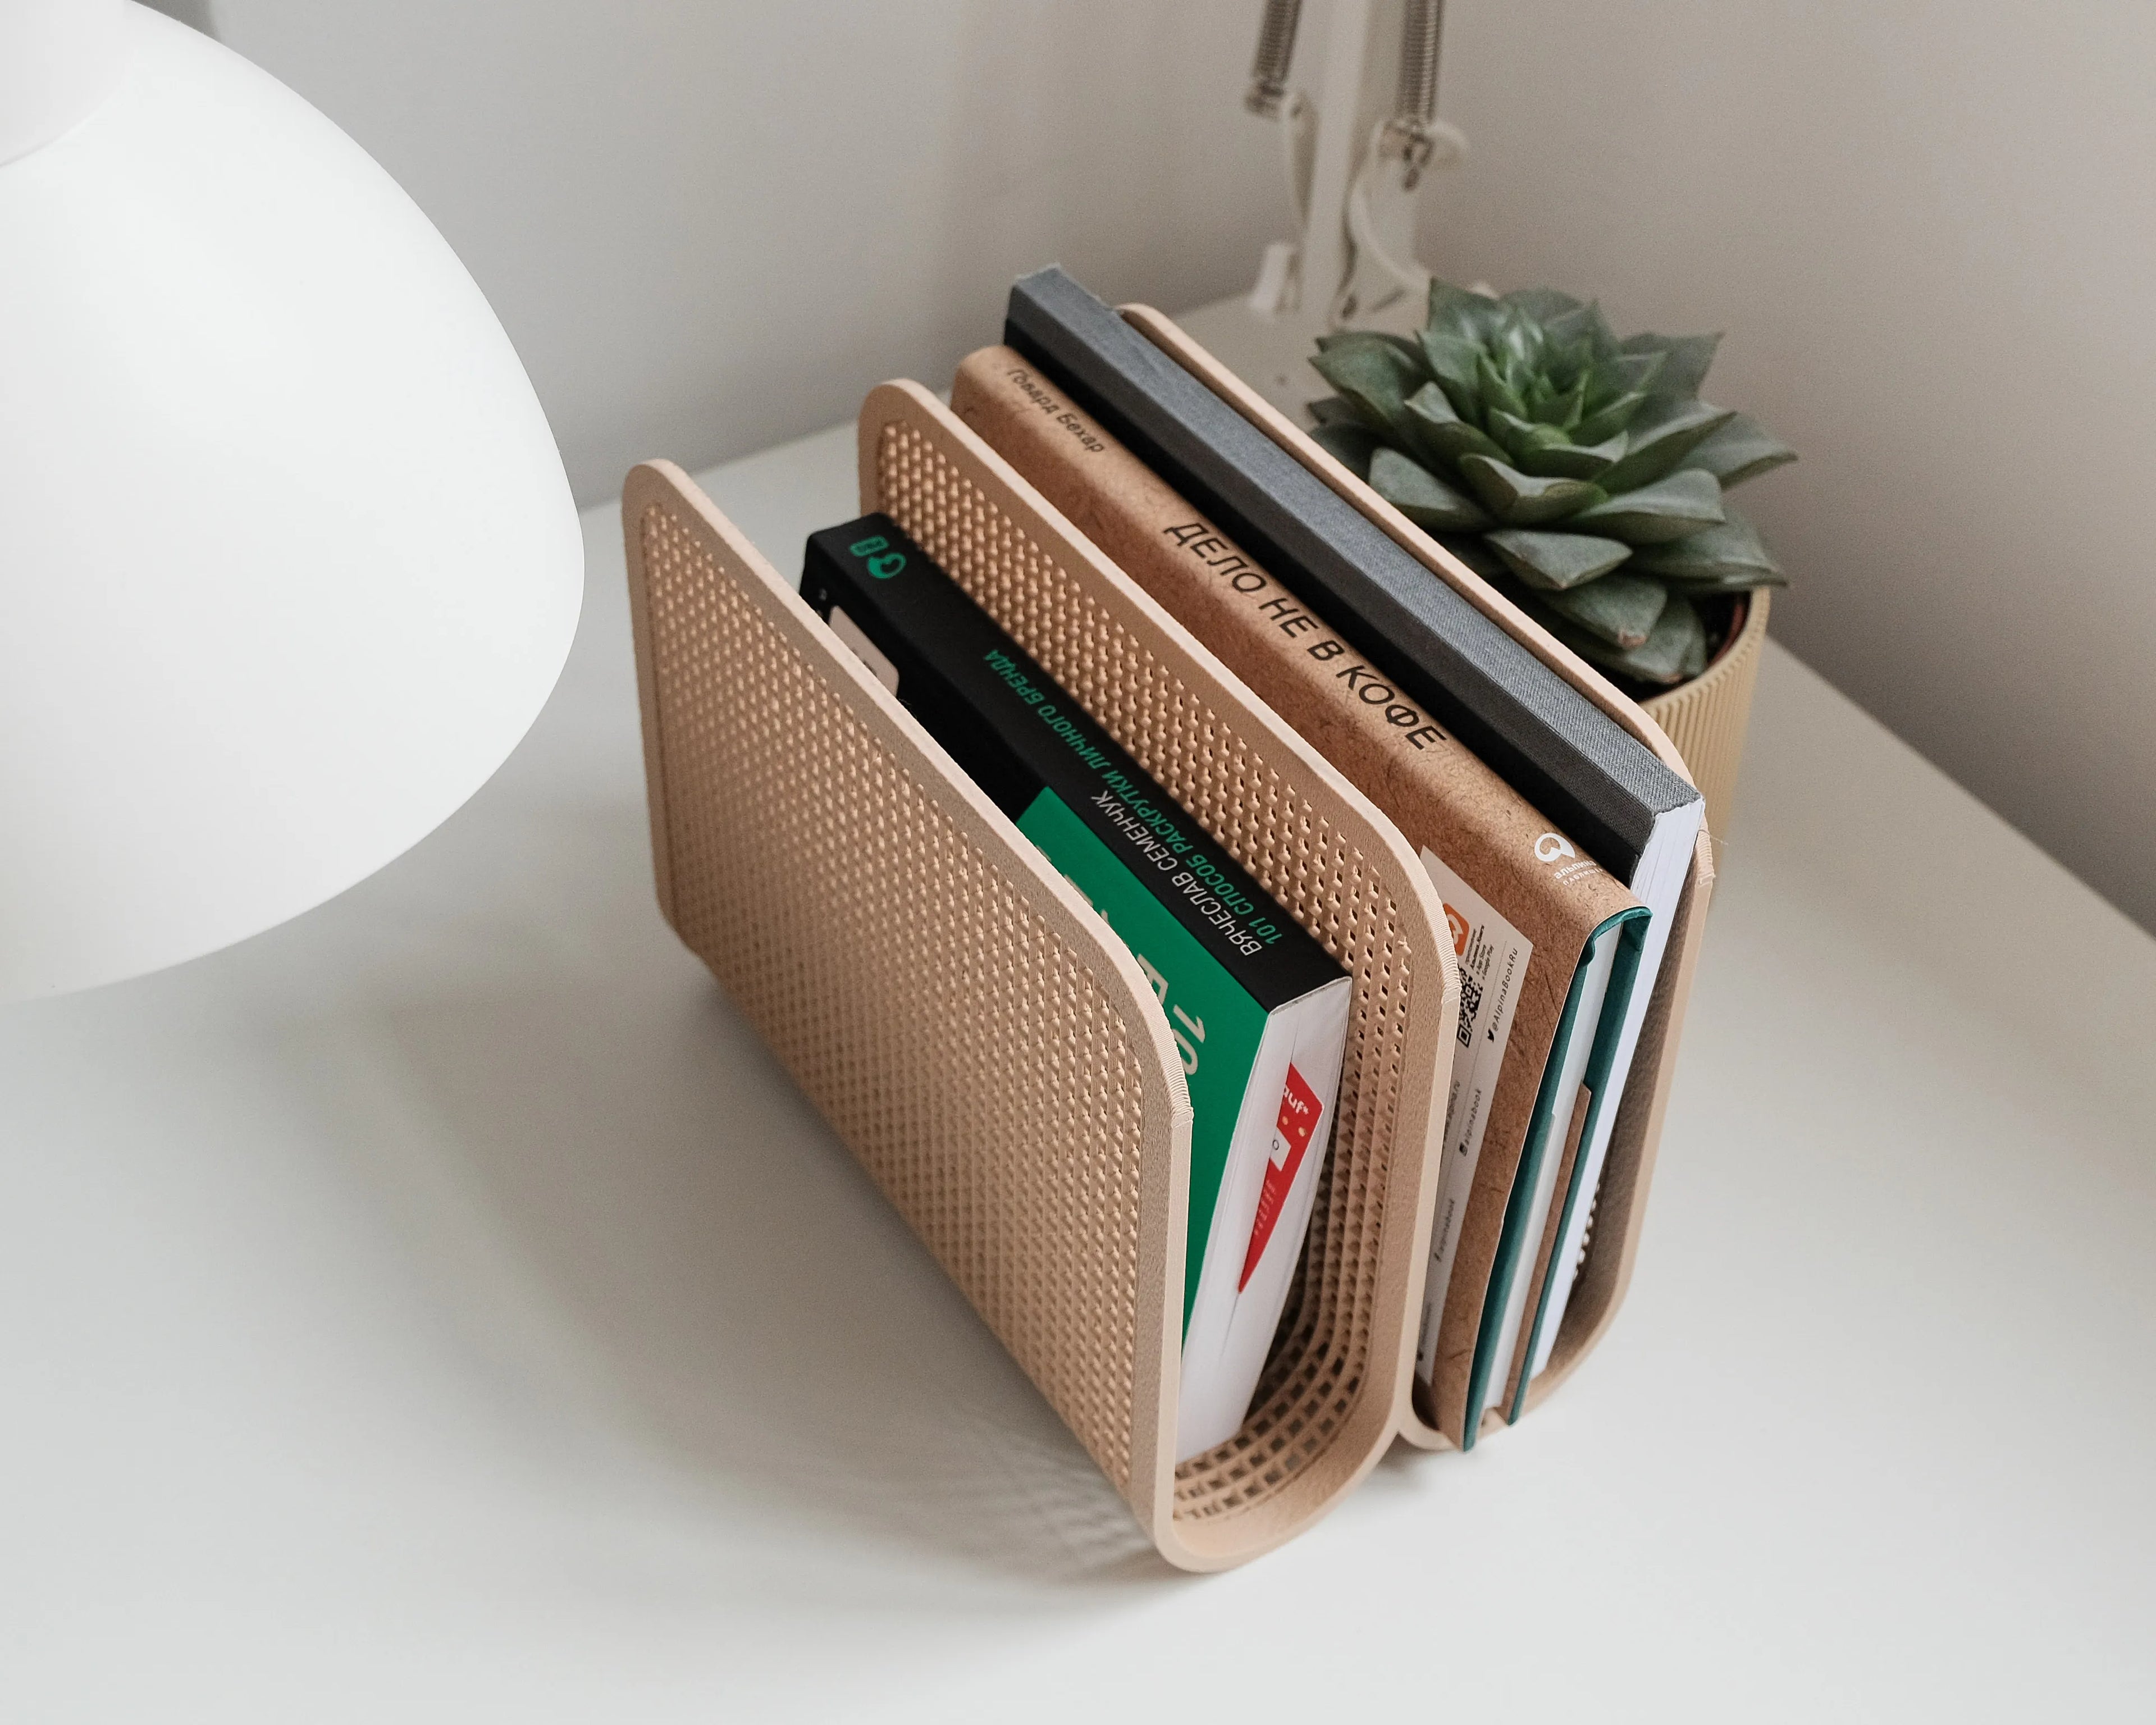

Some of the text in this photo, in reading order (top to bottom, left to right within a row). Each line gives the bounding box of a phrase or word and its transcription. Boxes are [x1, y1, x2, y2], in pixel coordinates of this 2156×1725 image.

[1007, 369, 1104, 453] Говард Бехар
[984, 649, 1045, 705] БРЕНДА
[1163, 522, 1447, 750] ДЕЛО НЕ В КОФЕ
[1038, 705, 1112, 769] ЛИЧНОГО
[1101, 770, 1194, 854] РАСКРУТКИ
[1090, 790, 1263, 956] ВЯЧЕСЛАВ СЕМЕНЧУК
[1185, 854, 1254, 915] СПОСОБ
[1248, 916, 1283, 944] 101
[1492, 947, 1518, 1032] @AlpinaBookRu
